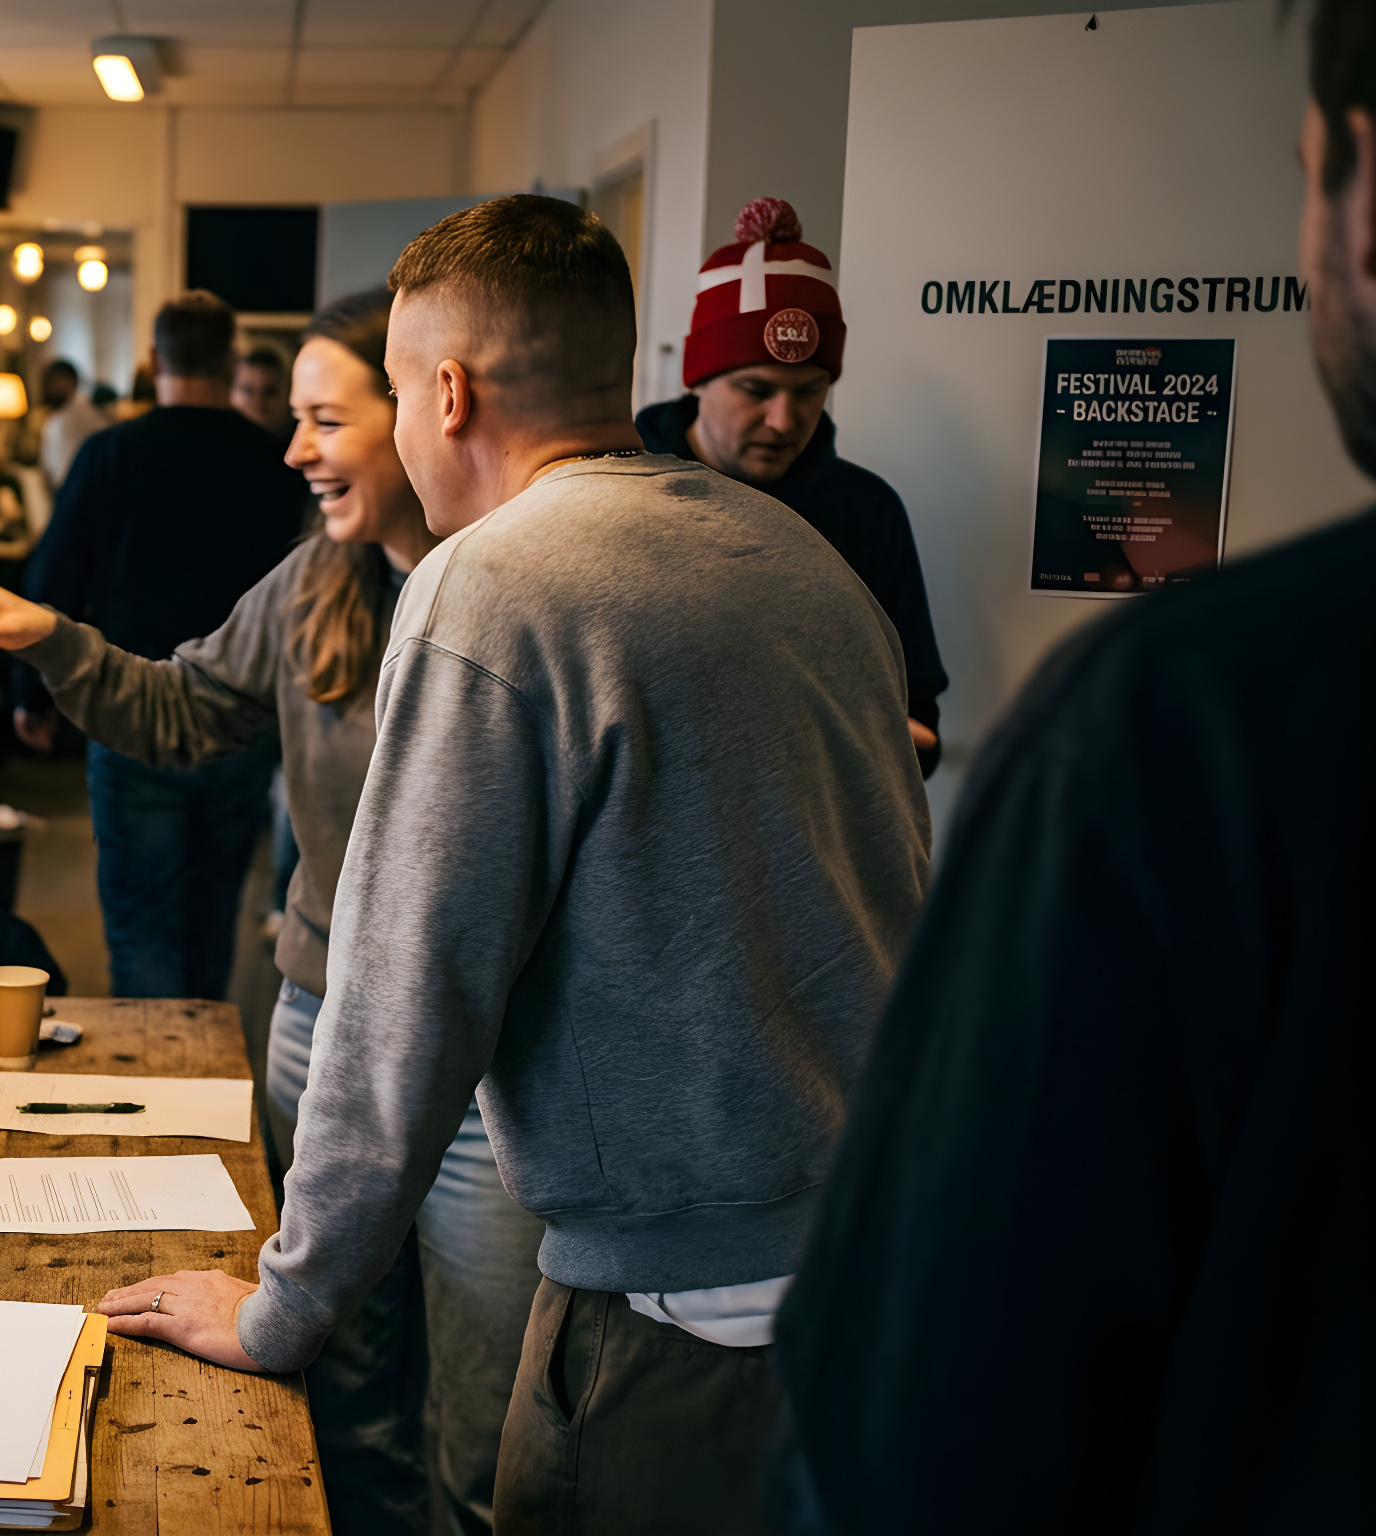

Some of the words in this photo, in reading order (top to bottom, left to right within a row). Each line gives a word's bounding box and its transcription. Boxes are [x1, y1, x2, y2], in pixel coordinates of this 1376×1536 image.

[1056, 373, 1156, 395] FESTIVAL
[1162, 374, 1219, 396] 2024
[1073, 400, 1200, 423] BACKSTAGE
